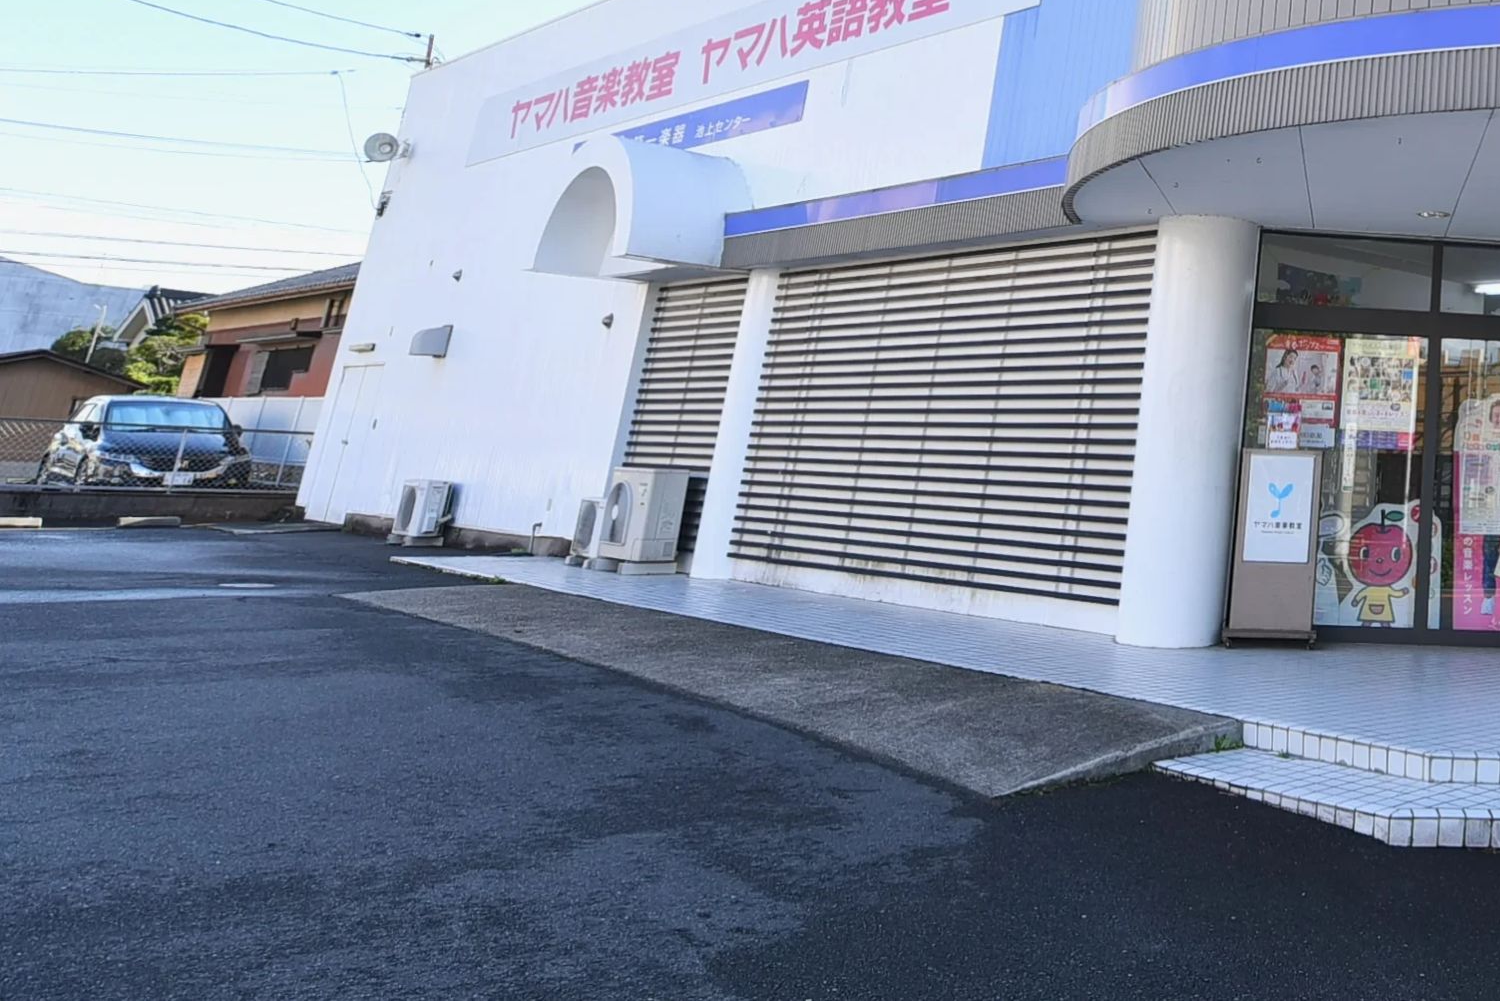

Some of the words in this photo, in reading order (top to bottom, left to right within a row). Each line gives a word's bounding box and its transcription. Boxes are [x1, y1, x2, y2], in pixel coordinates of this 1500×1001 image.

[511, 51, 681, 139] ヤマハ音楽教室
[695, 116, 751, 138] 池上センター
